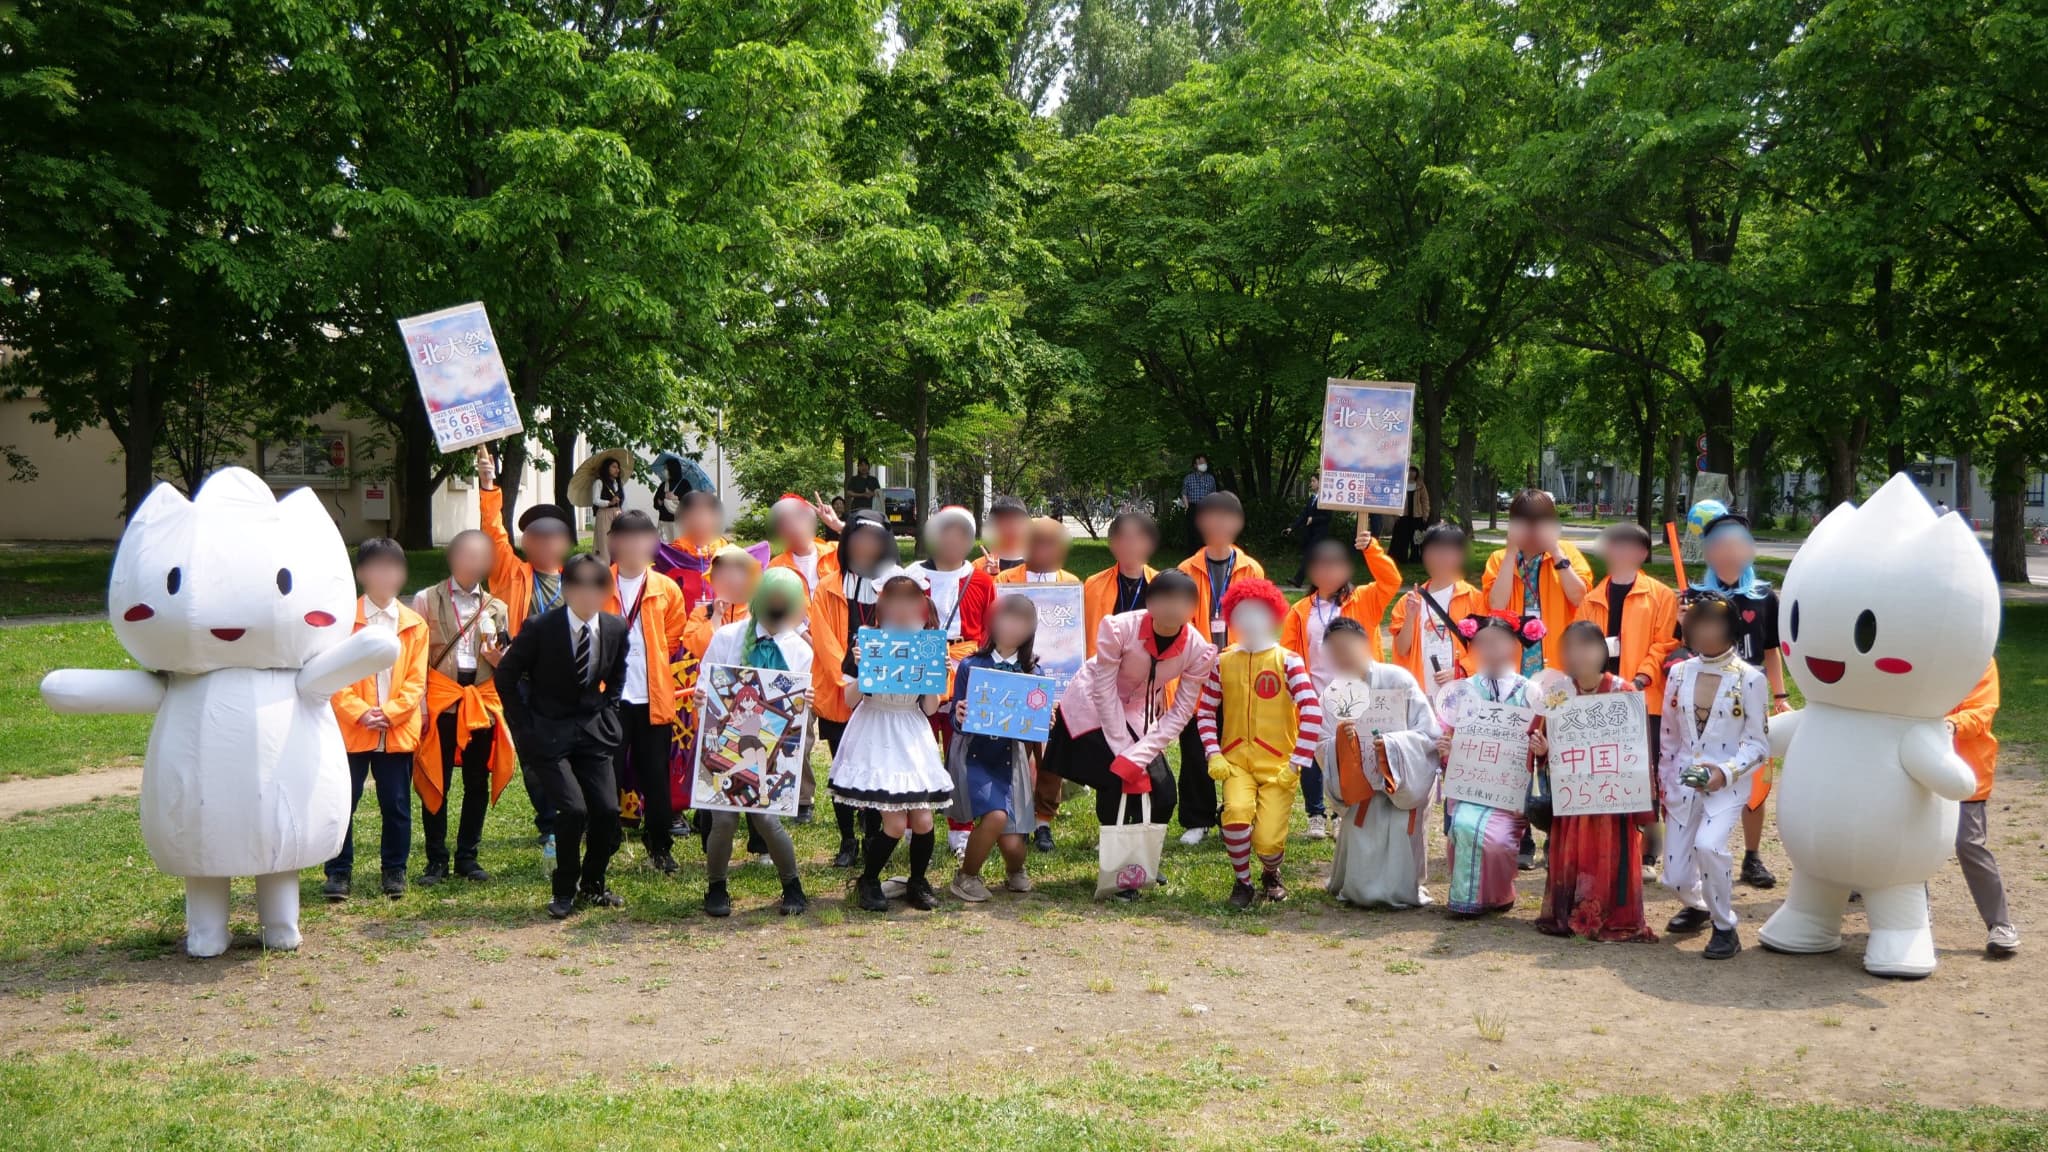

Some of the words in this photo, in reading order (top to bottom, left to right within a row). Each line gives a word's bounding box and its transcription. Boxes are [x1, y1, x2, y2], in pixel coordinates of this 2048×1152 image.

[421, 330, 489, 366] 北大祭
[1334, 406, 1403, 432] 北大祭
[1037, 604, 1075, 627] 大祭
[864, 639, 910, 659] 宝石
[873, 664, 942, 682] サイダー
[1560, 702, 1628, 731] 文系祭
[1561, 744, 1638, 775] 中国の
[1560, 779, 1641, 809] うらない
